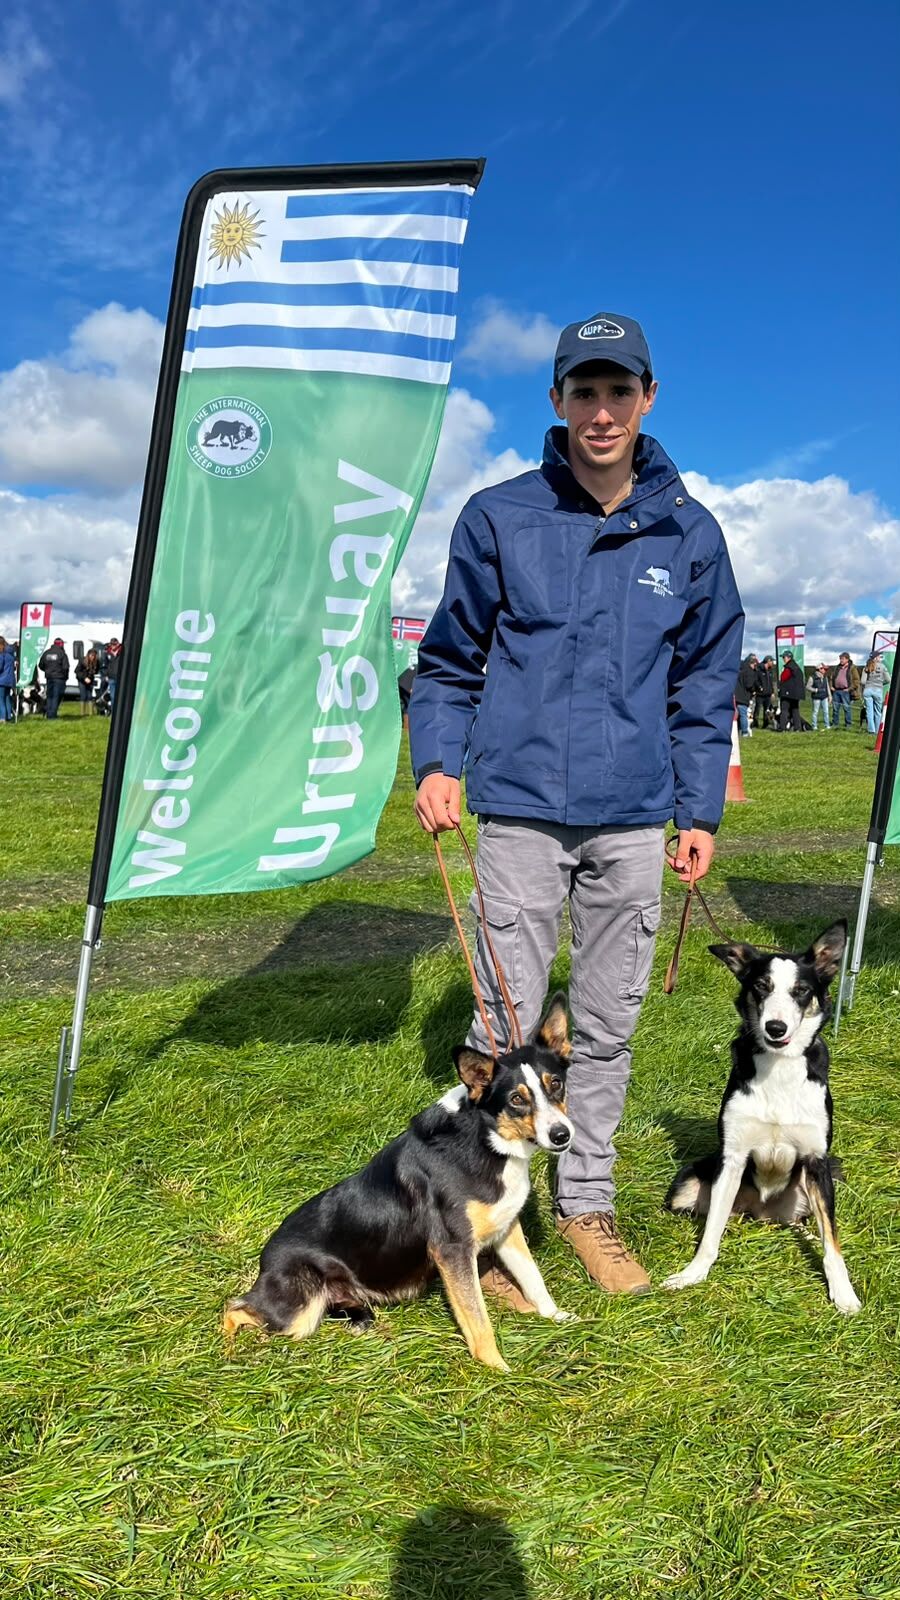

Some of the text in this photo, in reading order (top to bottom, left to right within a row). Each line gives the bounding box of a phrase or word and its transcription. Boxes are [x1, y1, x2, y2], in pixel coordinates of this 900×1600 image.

[583, 325, 603, 337] AUPP
[194, 399, 267, 428] THE INTERNATIONAL
[190, 445, 266, 476] SHEEP DOG SOCIETY
[256, 457, 415, 872] Uruguay
[128, 608, 215, 888] Welcome
